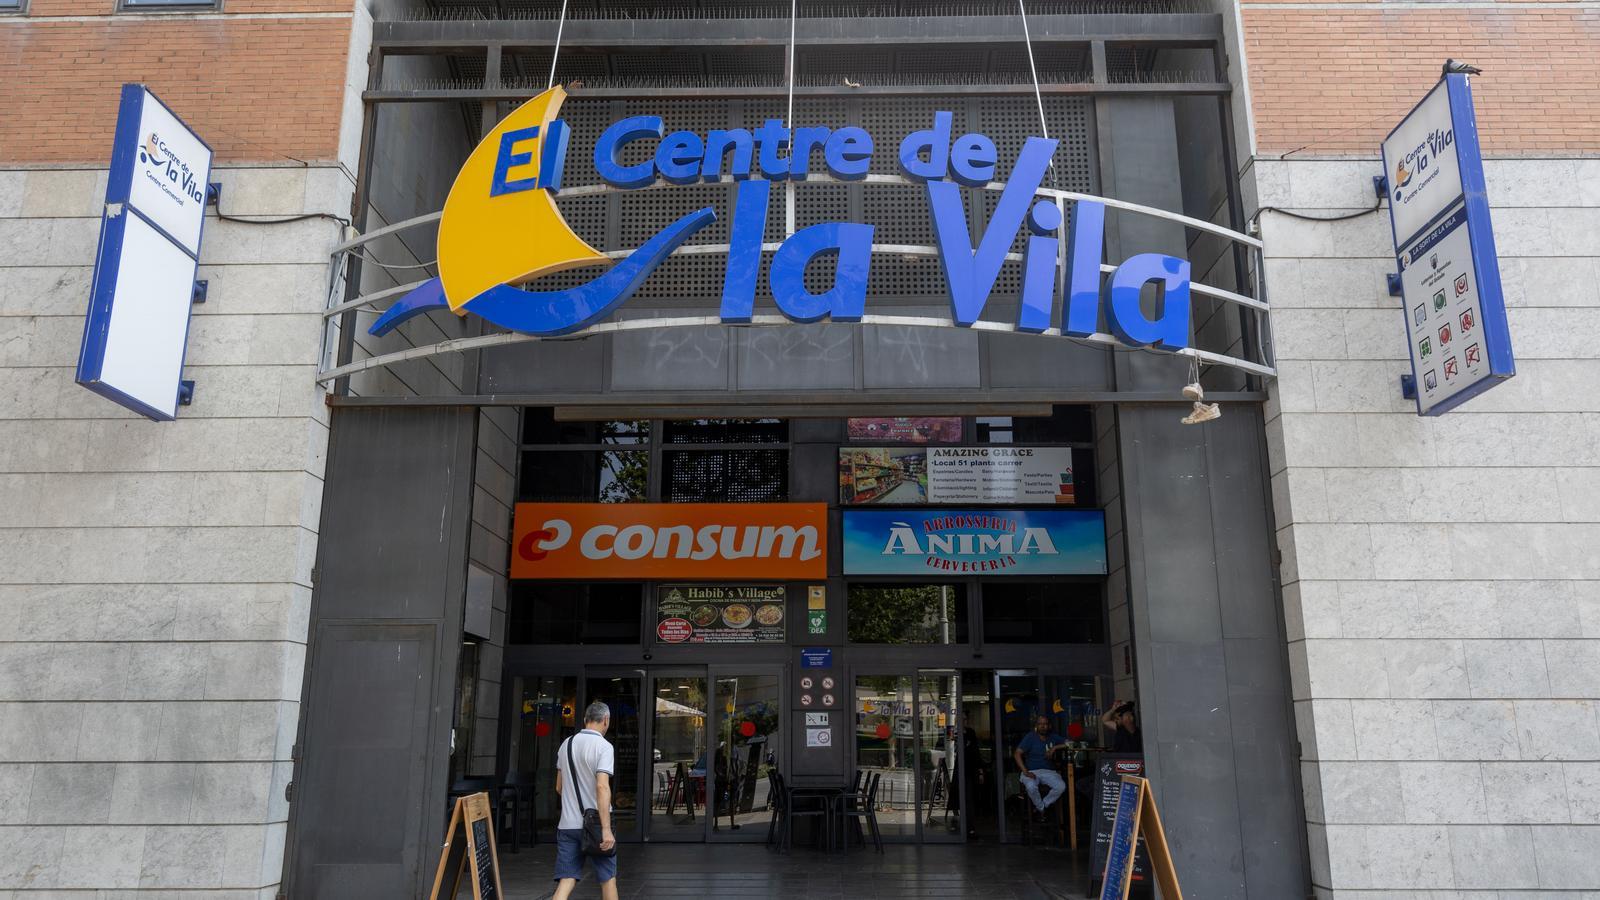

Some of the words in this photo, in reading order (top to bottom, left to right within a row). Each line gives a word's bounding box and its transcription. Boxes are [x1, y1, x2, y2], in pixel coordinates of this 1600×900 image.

[151, 133, 159, 145] El
[159, 141, 181, 166] Centre
[181, 163, 190, 174] de
[490, 118, 570, 197] El
[593, 115, 873, 188] Centre
[898, 110, 997, 187] de
[1398, 159, 1405, 171] El
[1405, 141, 1426, 164] Centre
[1426, 132, 1435, 143] de
[1416, 154, 1428, 174] la
[1430, 129, 1453, 159] Vila
[146, 170, 161, 187] Centre
[161, 184, 184, 207] Comercial
[165, 160, 178, 183] la
[181, 172, 203, 204] Vila
[1403, 189, 1418, 204] Centre
[720, 179, 875, 323] la
[926, 137, 1192, 351] Vila
[1419, 236, 1431, 250] SORT
[1444, 216, 1457, 229] VILA
[933, 448, 989, 457] AMAZING
[992, 448, 1033, 457] GRACE
[579, 524, 822, 561] consum
[881, 520, 1060, 555] ÀNIMA
[922, 515, 1018, 534] ARROSSERIA
[926, 555, 1017, 572] CERVECERIA
[736, 588, 778, 600] Village
